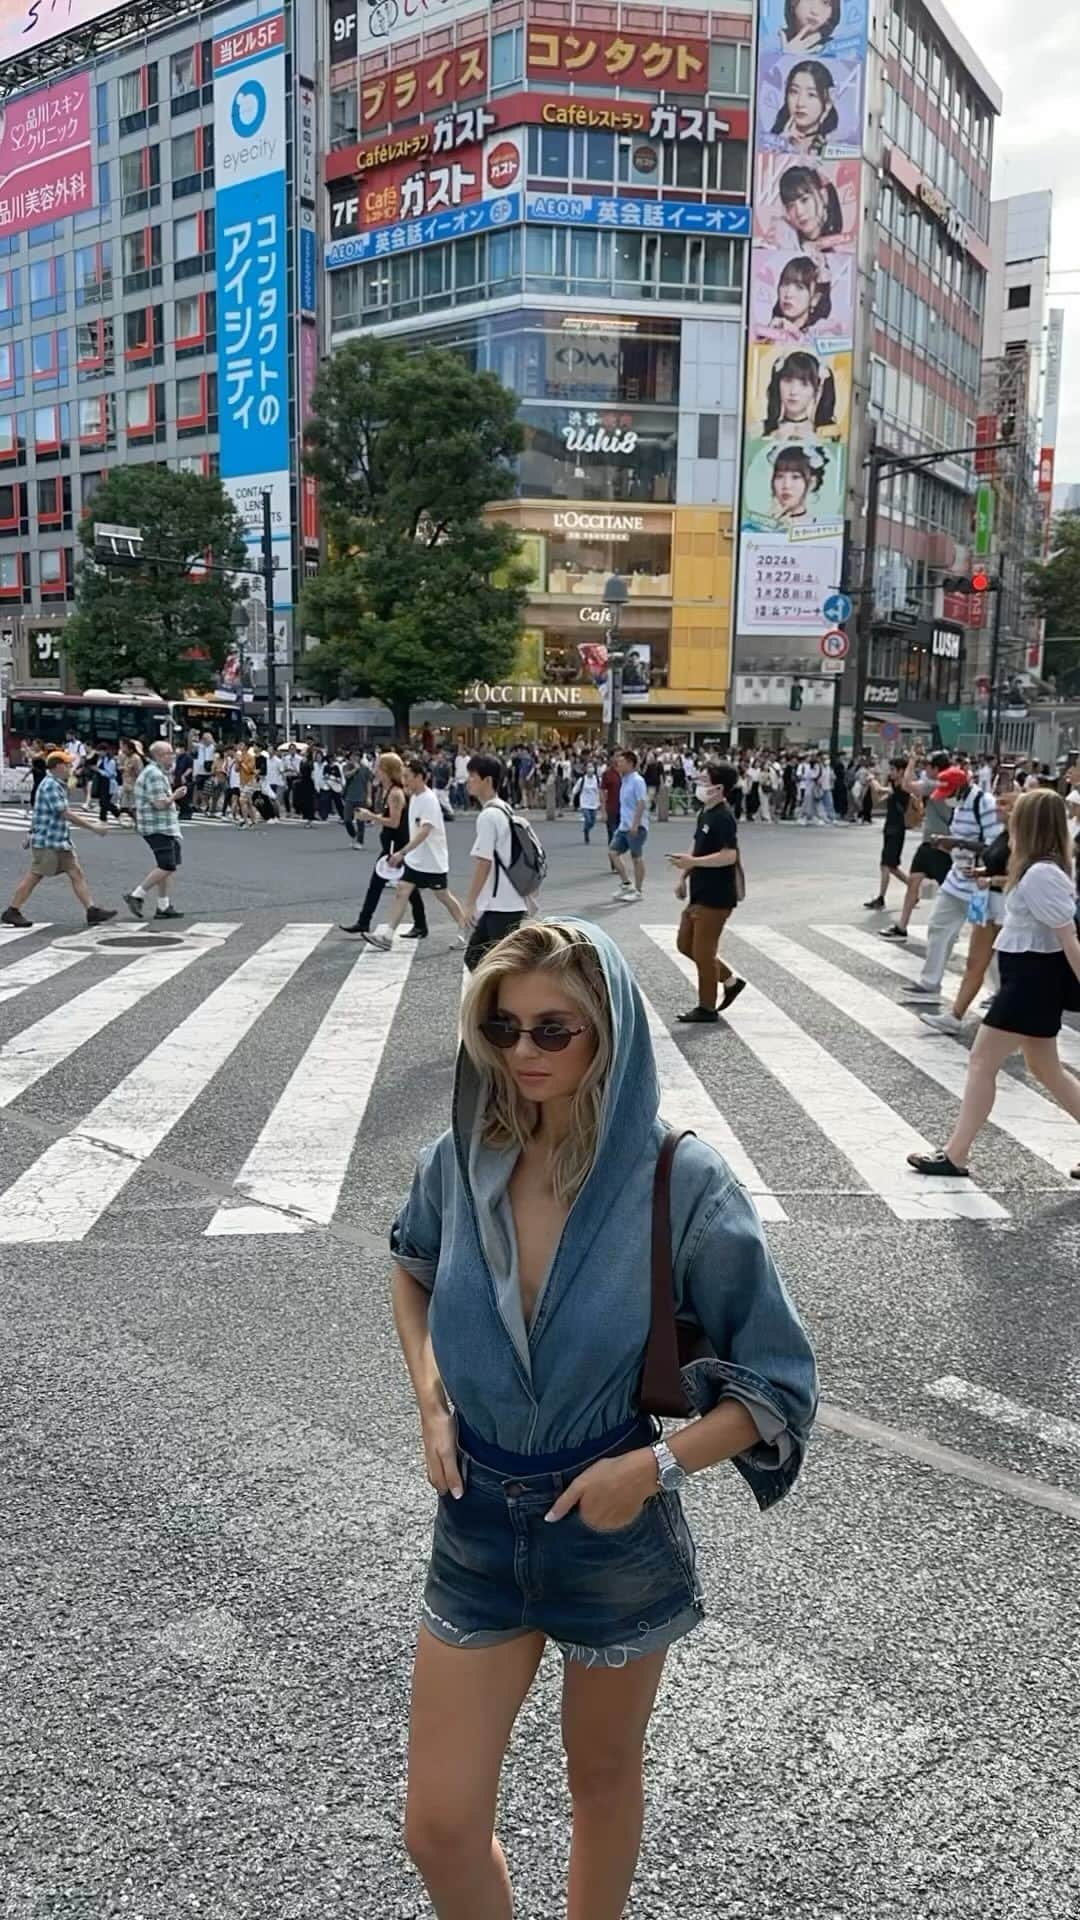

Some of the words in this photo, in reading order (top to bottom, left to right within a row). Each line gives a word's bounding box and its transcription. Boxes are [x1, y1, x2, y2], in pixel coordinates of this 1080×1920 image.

[219, 21, 278, 63] 当ビル5F
[333, 15, 356, 42] 9F
[528, 32, 703, 81] コンタクト
[362, 48, 485, 120] プライス
[26, 92, 84, 130] 品川スキン
[432, 107, 496, 153] ガスト
[650, 105, 730, 143] ガスト
[27, 119, 78, 154] クリニック
[222, 138, 277, 171] eyecity
[0, 171, 87, 225] 品川美容外科
[366, 186, 397, 211] Café
[400, 163, 476, 220] ガスト
[332, 197, 359, 228] 7F
[534, 199, 584, 217] AEON
[598, 201, 747, 232] 英会話イーオン
[331, 240, 364, 260] AEON
[375, 208, 485, 255] 英会話イーオン
[223, 220, 255, 430] アイシティ
[256, 214, 280, 426] コンタクトの
[562, 426, 638, 454] Ushi8
[553, 511, 643, 530] L'OCCITANE
[933, 629, 961, 659] LUSH
